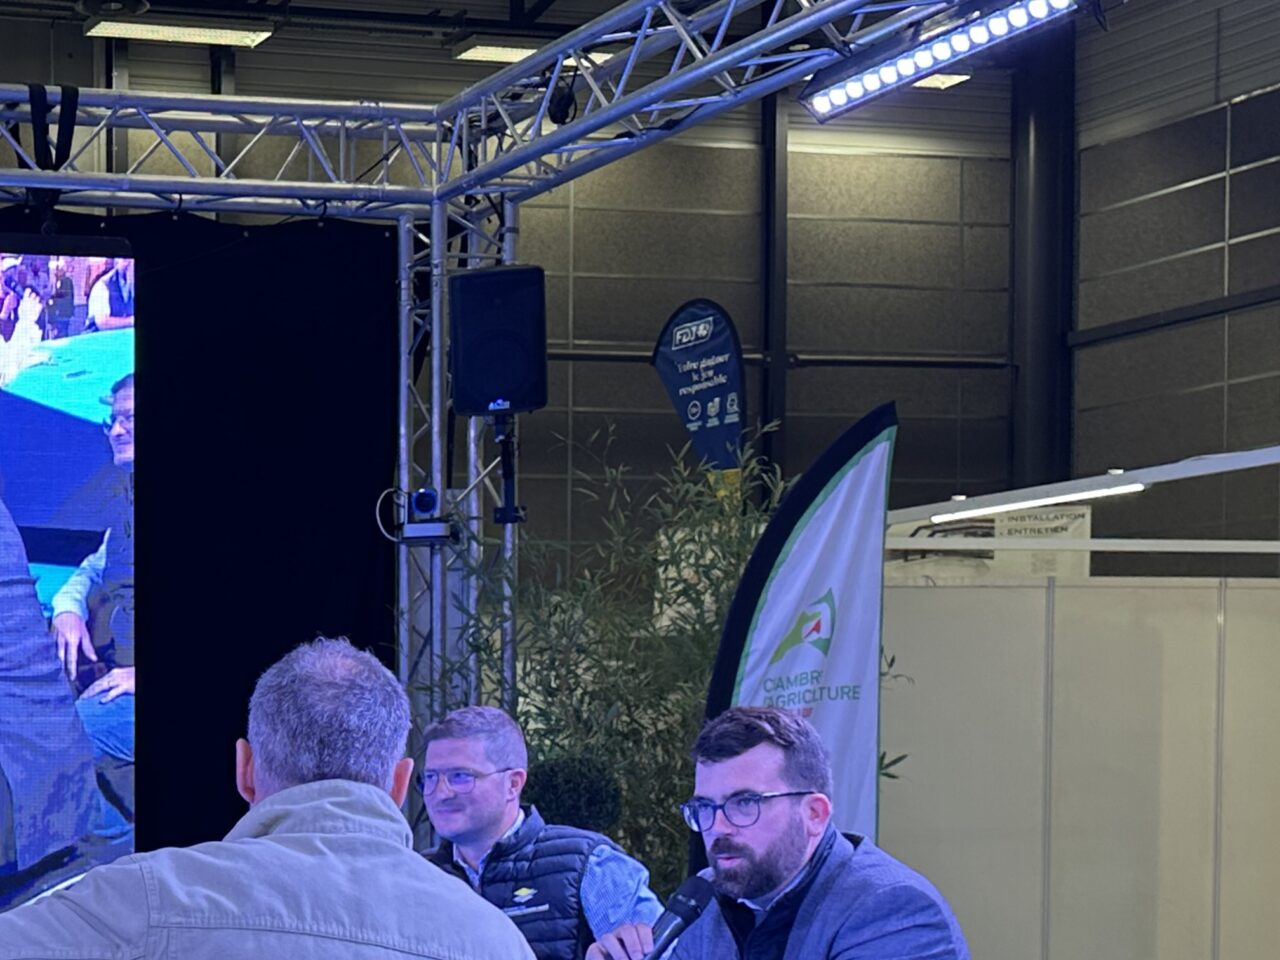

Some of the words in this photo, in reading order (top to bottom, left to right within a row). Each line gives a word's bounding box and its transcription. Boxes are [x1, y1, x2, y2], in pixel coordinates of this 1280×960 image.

[676, 326, 697, 345] FDJ
[1007, 512, 1086, 523] INSTALLATION
[1007, 525, 1069, 536] ENTRETIEN
